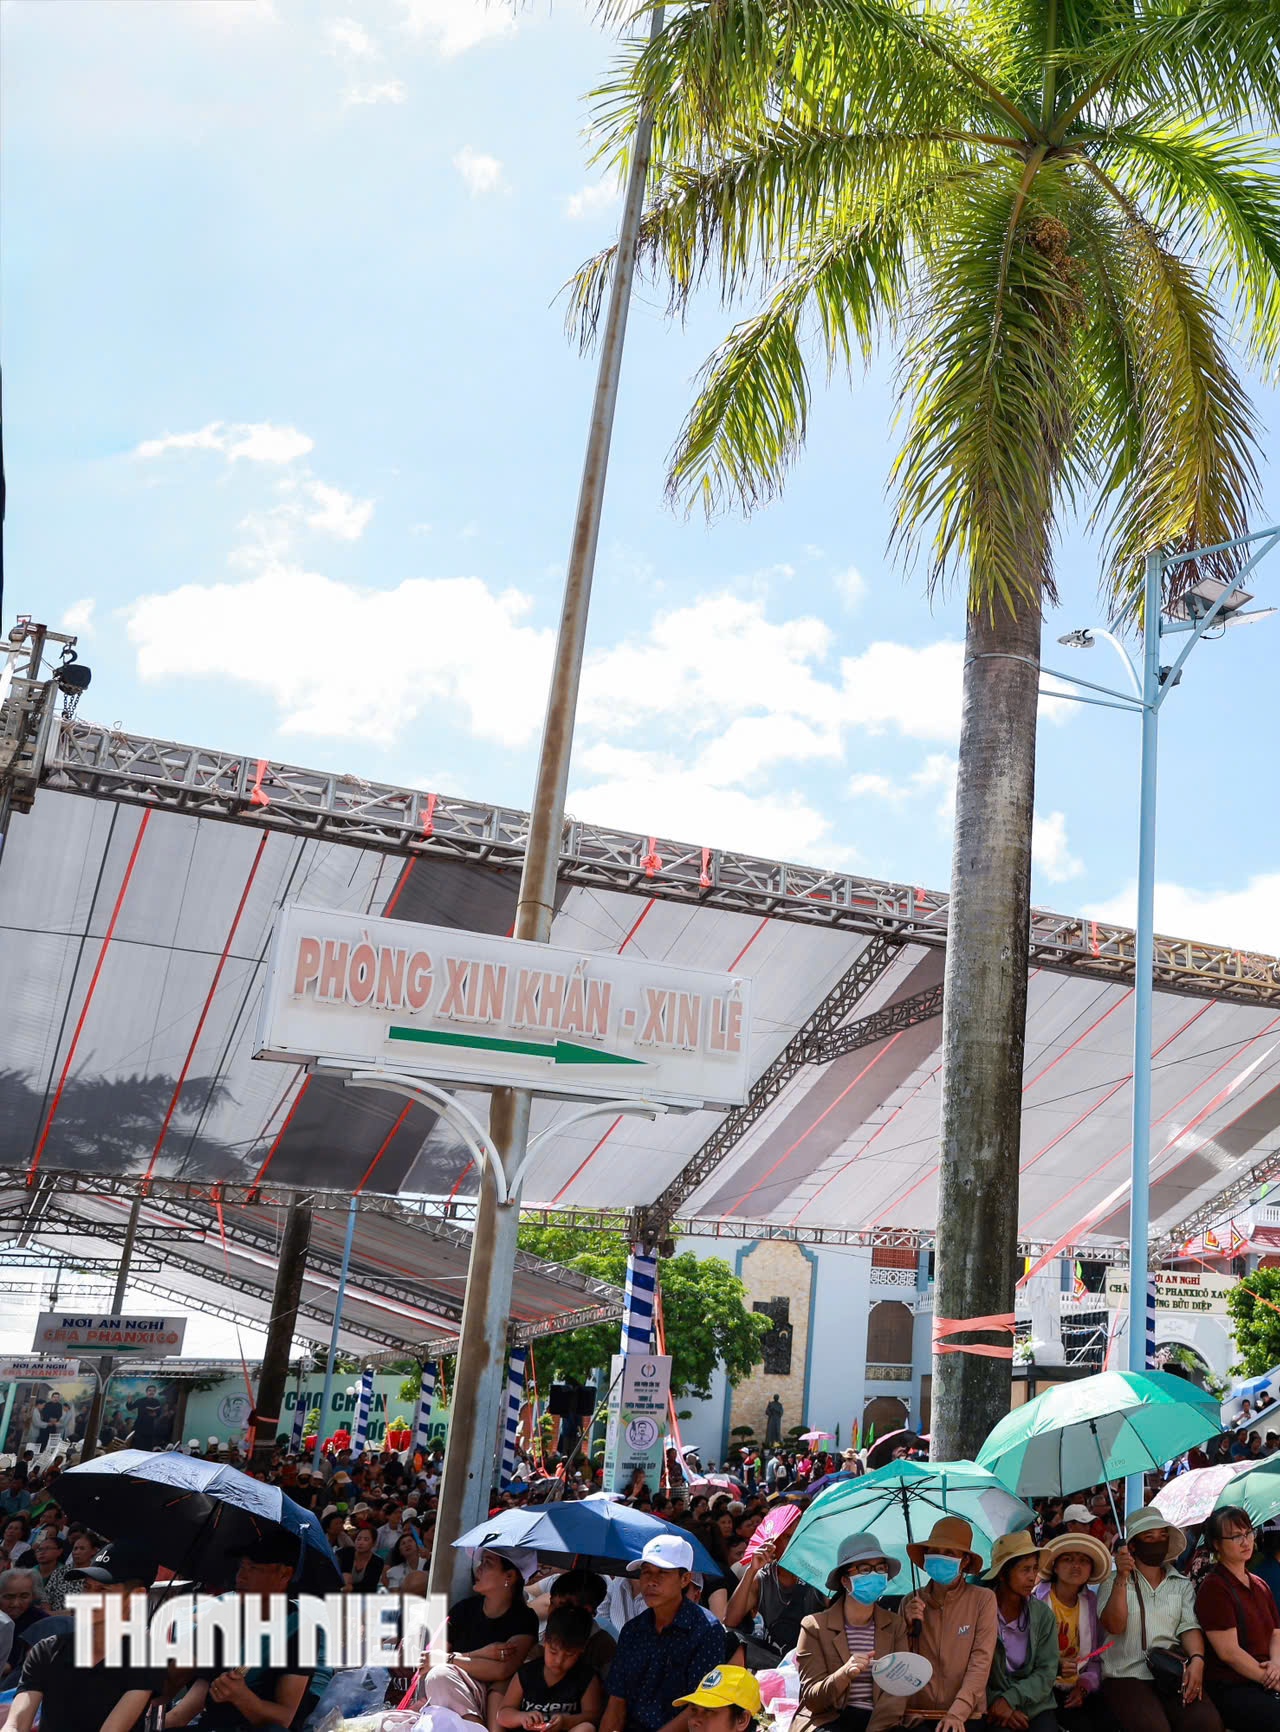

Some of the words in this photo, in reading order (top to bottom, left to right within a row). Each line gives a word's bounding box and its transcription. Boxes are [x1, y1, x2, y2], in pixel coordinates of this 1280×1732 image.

[292, 929, 433, 1010] PHÒNG
[438, 955, 507, 1022] XIN
[512, 958, 612, 1039] KHẤN
[641, 985, 700, 1050] XIN
[1165, 1275, 1178, 1284] AN
[62, 1318, 93, 1329] NƠI
[99, 1319, 117, 1329] AN
[125, 1318, 165, 1330] NGHỈ
